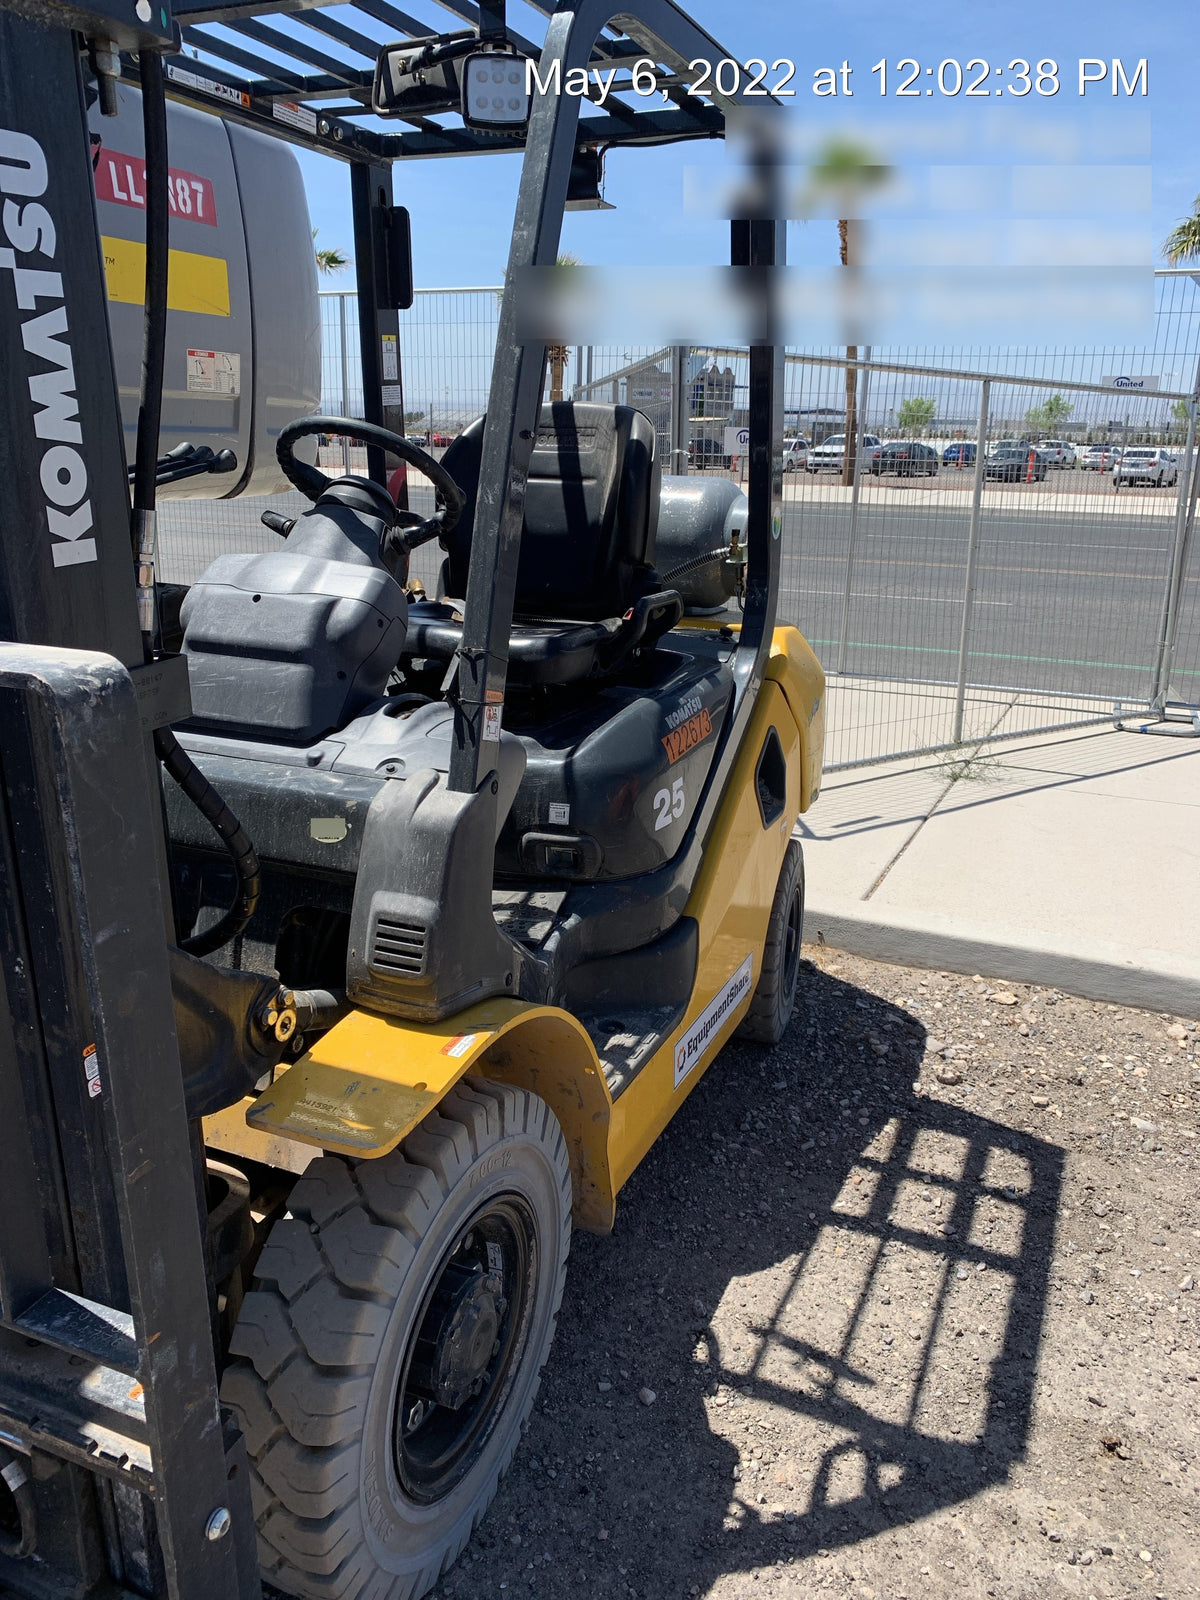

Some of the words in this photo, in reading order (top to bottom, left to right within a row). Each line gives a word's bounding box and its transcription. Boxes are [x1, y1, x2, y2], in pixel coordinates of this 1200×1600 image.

[0, 129, 98, 568] KOMATSU
[1116, 380, 1144, 388] United
[665, 696, 703, 729] KOMATSU
[665, 709, 712, 760] 122673
[653, 776, 685, 831] 25
[687, 970, 750, 1059] EquipmentShare
